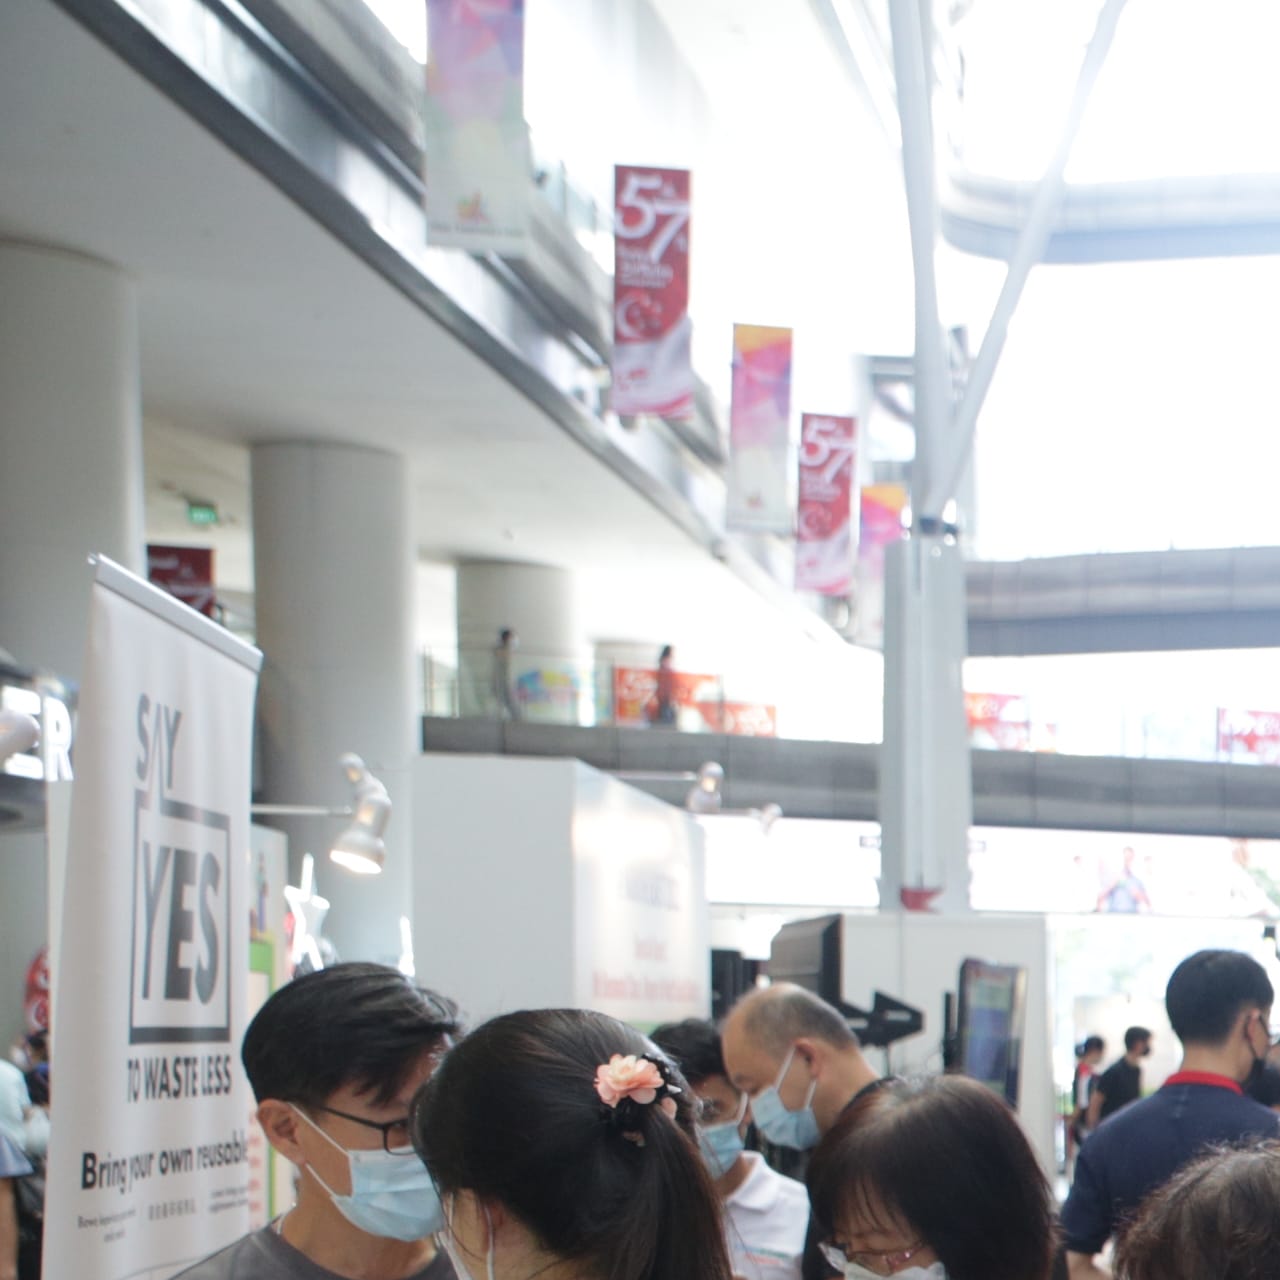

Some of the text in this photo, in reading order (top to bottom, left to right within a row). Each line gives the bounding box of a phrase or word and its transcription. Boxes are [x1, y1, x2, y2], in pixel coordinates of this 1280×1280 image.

[615, 174, 691, 264] 57
[136, 692, 182, 790] SAY
[141, 840, 221, 1006] YES
[127, 1054, 232, 1103] TO WASTE LESS
[81, 1151, 127, 1195] Bring
[128, 1152, 155, 1192] your
[159, 1148, 194, 1177] own
